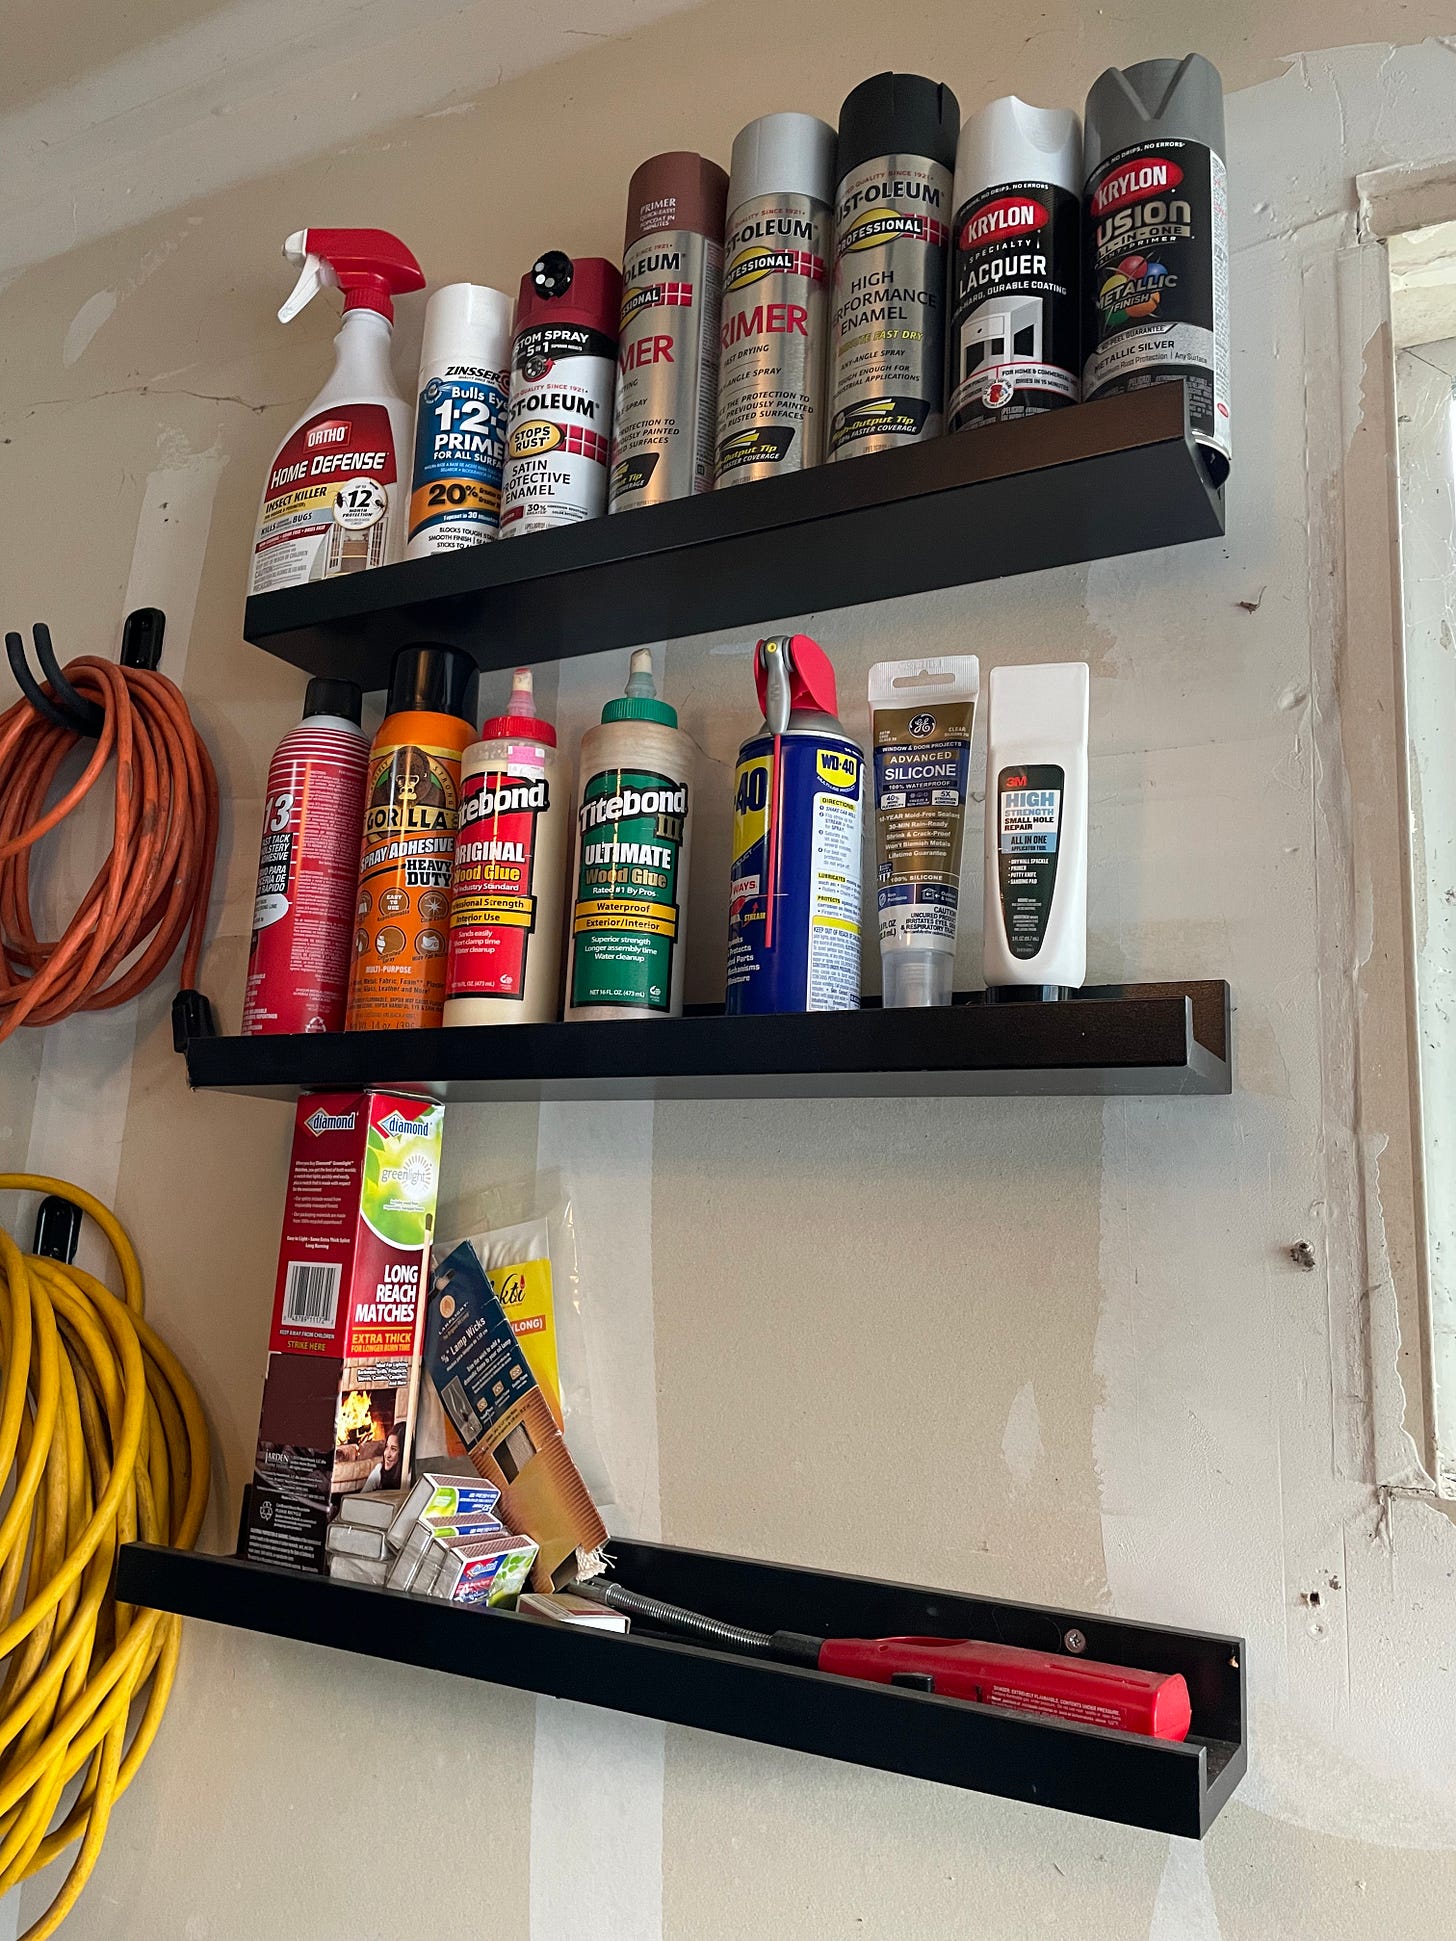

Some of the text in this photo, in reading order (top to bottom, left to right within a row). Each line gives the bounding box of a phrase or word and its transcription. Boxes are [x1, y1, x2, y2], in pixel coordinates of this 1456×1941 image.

[1099, 166, 1166, 210] KRYLON
[640, 198, 676, 215] PRIMER
[968, 206, 1034, 244] KRYLON
[969, 240, 1031, 264] SPECIALTY
[851, 271, 894, 294] HIGH
[960, 255, 1046, 300] LACQUER
[988, 281, 1029, 296] DURABLE
[1031, 281, 1067, 295] COATING
[1114, 294, 1150, 312] FINISH
[840, 306, 907, 336] ENAMEL
[544, 330, 590, 344] SPRAY
[902, 330, 924, 341] DRY
[1126, 324, 1164, 338] GUARANTEE
[738, 344, 770, 359] DRYING
[1138, 340, 1175, 352] SILVER
[1175, 352, 1187, 362] Any
[445, 366, 500, 383] ZINSSER
[753, 368, 782, 376] SPRAY
[860, 366, 892, 375] ENOUGH
[865, 374, 920, 382] APPLICATIONS
[452, 387, 484, 400] Bulls
[800, 394, 810, 402] TO
[726, 401, 774, 419] PREVIOUSLY
[728, 410, 804, 427] RUSTED SURFACES
[896, 416, 914, 424] Tip
[514, 426, 550, 443] STOPS
[877, 424, 917, 433] COVERAGE
[307, 427, 345, 447] ORTHO
[516, 436, 547, 452] RUST
[434, 452, 451, 460] FOR
[271, 452, 386, 489] HOME DEFENSE
[512, 460, 548, 476] SATIN
[266, 487, 327, 513] INSECT KILLER
[348, 490, 373, 508] 12
[428, 484, 478, 506] 20%
[506, 484, 555, 504] ENAMEL
[821, 754, 854, 776] WD-40
[890, 752, 952, 764] ADVANCED
[885, 764, 956, 780] SILICONE
[906, 781, 951, 789] WATERPROOF
[1006, 776, 1028, 787] 3M
[1006, 792, 1054, 808] HIGH
[580, 788, 686, 832] Titebond
[938, 812, 960, 820] Sealant
[1005, 808, 1054, 816] STRENGTH
[272, 834, 291, 844] TACK
[1011, 836, 1047, 845] ALL IN ONE
[361, 838, 454, 872] SPRAY ADHESIVE
[585, 842, 671, 870] ULTIMATE
[888, 851, 912, 859] Lifetime
[270, 865, 286, 874] PARA
[407, 860, 452, 872] HEAVY
[484, 865, 520, 880] Glue
[276, 874, 286, 882] DE
[408, 872, 452, 886] DUTY
[586, 868, 667, 888] Wood Glue
[627, 887, 637, 895] By
[484, 899, 524, 908] Strength
[597, 902, 650, 912] Waterproof
[621, 936, 650, 946] strength
[607, 946, 641, 954] assembly
[616, 953, 644, 962] cleanup
[736, 954, 754, 962] Parts
[314, 1112, 354, 1130] diamond
[389, 1118, 428, 1137] diamond
[382, 1168, 426, 1182] greenlight
[384, 1264, 418, 1284] LONG
[376, 1284, 416, 1302] REACH
[355, 1304, 414, 1322] MATCHES
[352, 1332, 411, 1344] EXTRA THICK
[448, 1315, 486, 1355] Lamp Wicks
[288, 1340, 326, 1351] STRIKE HERE
